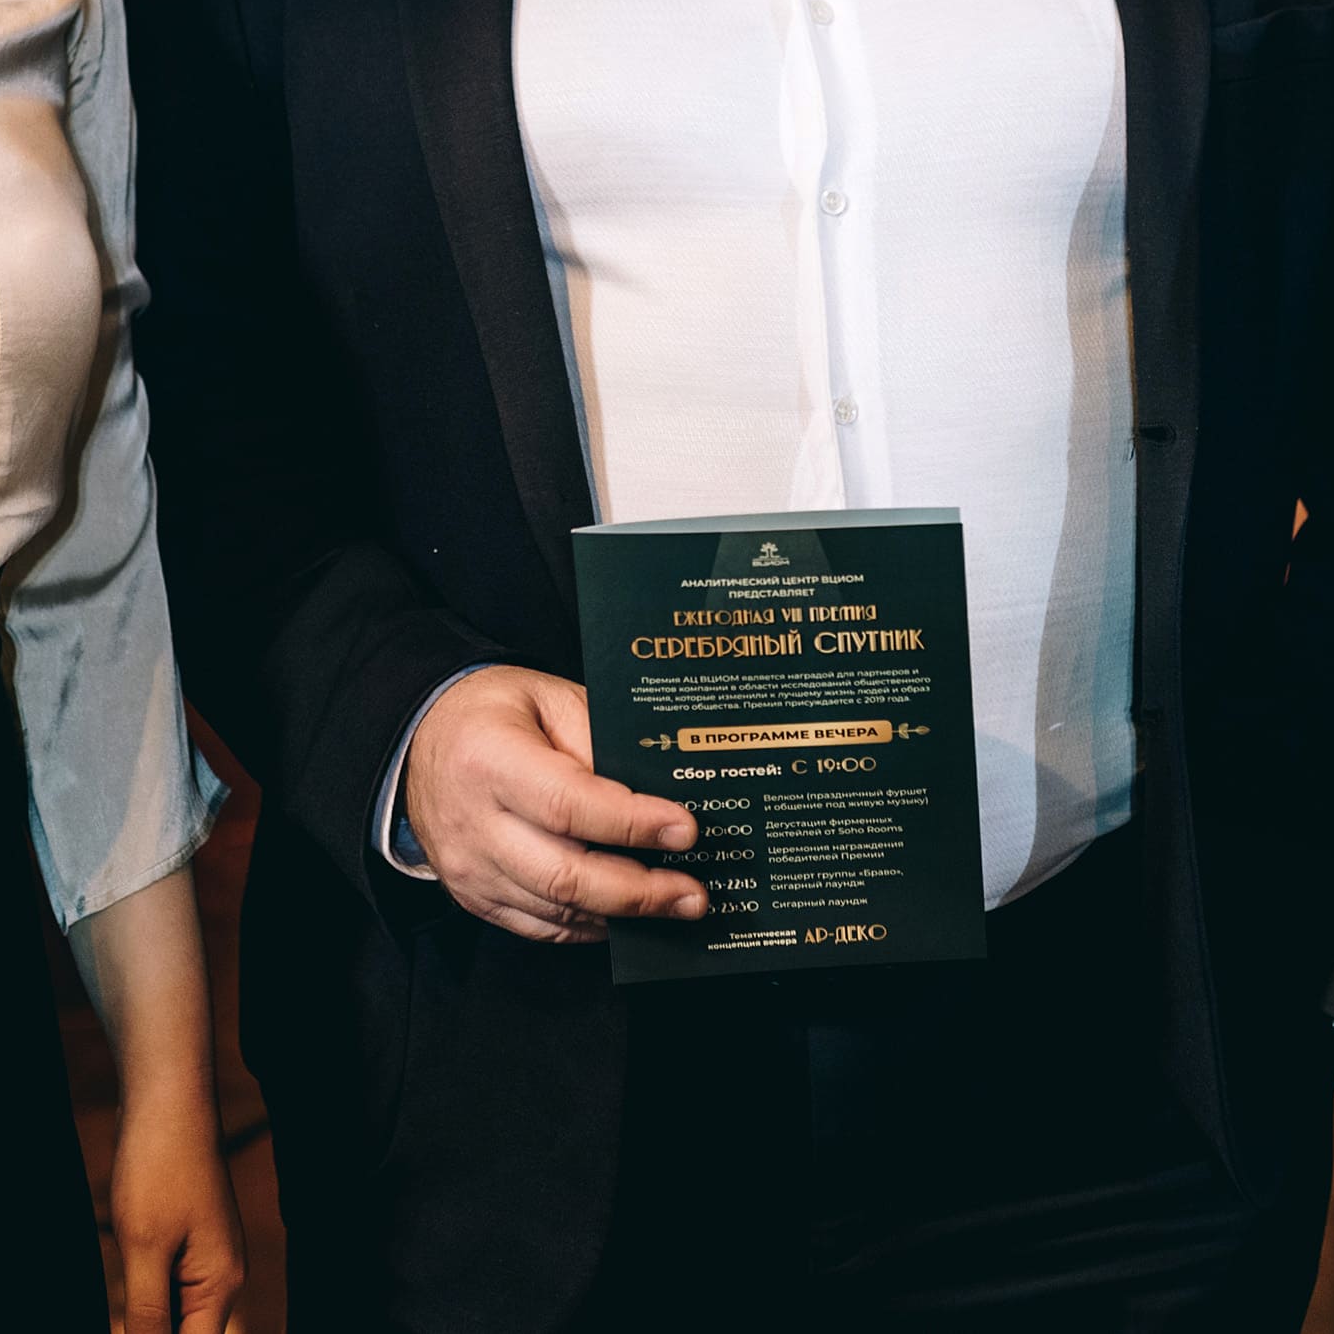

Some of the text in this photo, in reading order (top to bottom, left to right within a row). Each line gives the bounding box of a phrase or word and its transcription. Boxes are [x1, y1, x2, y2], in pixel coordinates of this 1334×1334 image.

[681, 574, 864, 587] АНАЛИТИЧЕСКИЙ ЦЕНТР ВЦИОМ
[728, 588, 816, 600] ПРЕДСТАВЛЯЕТ
[673, 608, 775, 626] ЕЖЕГОДНАЯ
[809, 604, 877, 622] ПРЕМИЯ
[631, 628, 925, 659] СЕРЕБРЯНЫЙ СПУТНИК
[641, 676, 681, 685] Премия
[683, 676, 698, 684] АЦ
[700, 674, 740, 684] ВЦИОМ
[741, 674, 785, 682] является
[787, 671, 835, 680] наградой
[836, 671, 855, 679] для
[857, 669, 910, 678] партнеров
[679, 685, 729, 693] компании
[738, 682, 779, 691] области
[781, 680, 852, 689] исследований
[853, 677, 932, 687] общественного
[675, 694, 716, 703] которые
[718, 693, 768, 701] изменили
[777, 690, 822, 699] лучшему
[857, 686, 890, 695] людей
[900, 685, 930, 693] образ
[652, 704, 690, 712] нашего
[743, 701, 783, 709] Премия
[784, 698, 854, 708] присуждается
[864, 696, 886, 704] 2019
[690, 727, 878, 744] В ПРОГРАММЕ ВЕЧЕРА
[672, 767, 716, 781] Сбор
[720, 763, 782, 778] гостей:
[817, 757, 877, 774] 19:00
[763, 787, 928, 802] Велком (праздничный фуршет
[774, 801, 823, 811] общение
[825, 801, 846, 809] под
[848, 799, 885, 808] живую
[887, 796, 929, 806] музыку)
[765, 817, 893, 830] Дегустация фирменных
[766, 829, 822, 838] коктейлей
[838, 826, 865, 835] Soho
[867, 825, 903, 834] Rooms
[768, 841, 904, 855] Церемония награждения
[768, 851, 885, 863] победителей Премии
[770, 872, 815, 882] Концерт
[817, 870, 856, 880] группы
[770, 879, 866, 891] сигарный лаундж
[771, 897, 868, 909] Сигарный лаундж
[729, 929, 797, 940] Тематическая
[804, 923, 888, 944] АР-ДЕКО
[708, 938, 797, 951] концепция вечера
